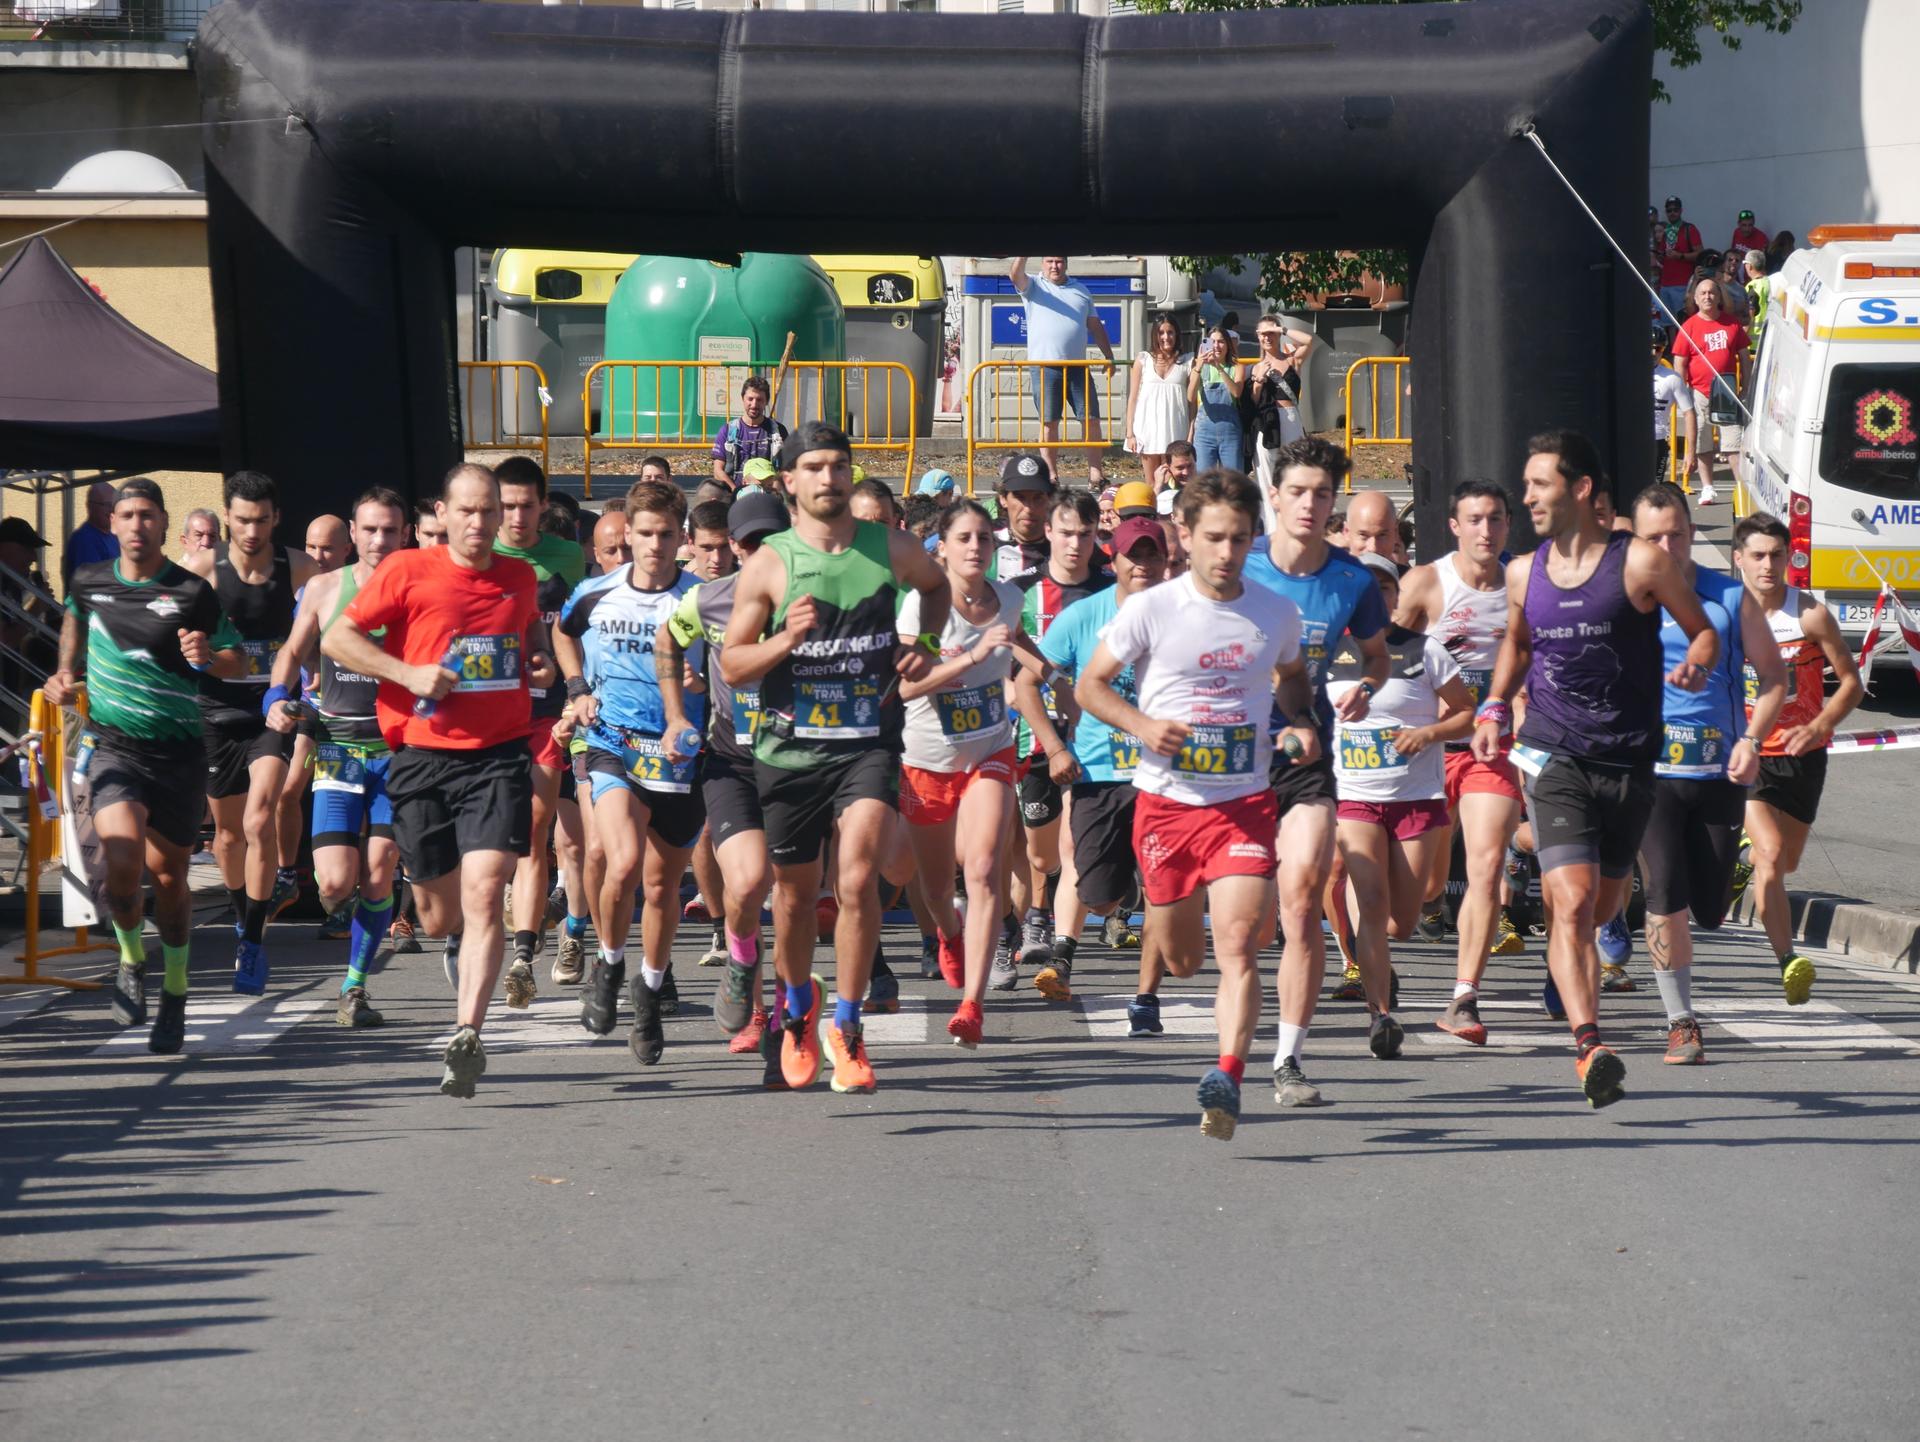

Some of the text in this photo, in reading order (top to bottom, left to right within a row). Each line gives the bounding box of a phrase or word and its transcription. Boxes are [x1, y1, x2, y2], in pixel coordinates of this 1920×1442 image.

[1855, 450, 1917, 460] ambuiberica
[1535, 621, 1612, 639] Areta Trail
[467, 642, 497, 655] TRAIL
[463, 655, 494, 680] 68
[814, 689, 848, 701] TRAIL
[953, 694, 983, 709] TRAIL
[807, 703, 843, 728] 41
[951, 707, 982, 733] 80
[1193, 733, 1227, 744] TRAIL
[1351, 735, 1376, 745] TRAIL
[1669, 731, 1698, 742] TRAIL
[1178, 746, 1228, 773] 102
[1343, 746, 1381, 768] 106
[1668, 742, 1684, 764] 9
[632, 756, 662, 779] 42
